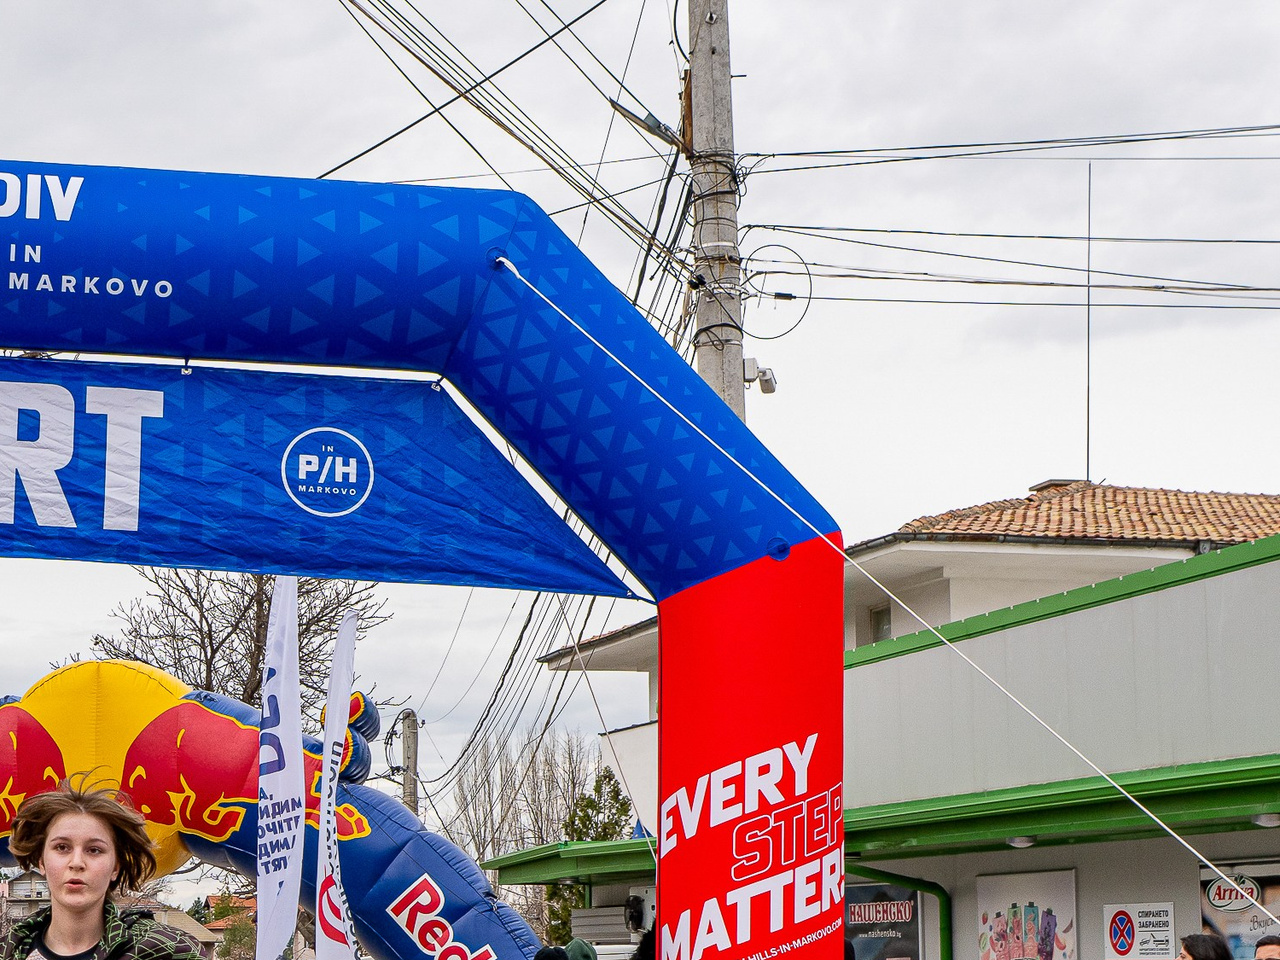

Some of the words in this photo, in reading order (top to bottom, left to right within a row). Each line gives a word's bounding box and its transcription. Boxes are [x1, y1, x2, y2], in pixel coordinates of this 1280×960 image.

[9, 243, 41, 263] IN
[9, 272, 173, 298] MARKOVO
[322, 444, 334, 453] IN
[298, 454, 357, 483] P/H
[298, 485, 357, 496] MARKOVO
[660, 732, 819, 859] EVERY
[731, 782, 842, 881] STEP
[849, 901, 913, 924] НАШЕНСКО
[1138, 910, 1169, 918] СПИРАНЕТО
